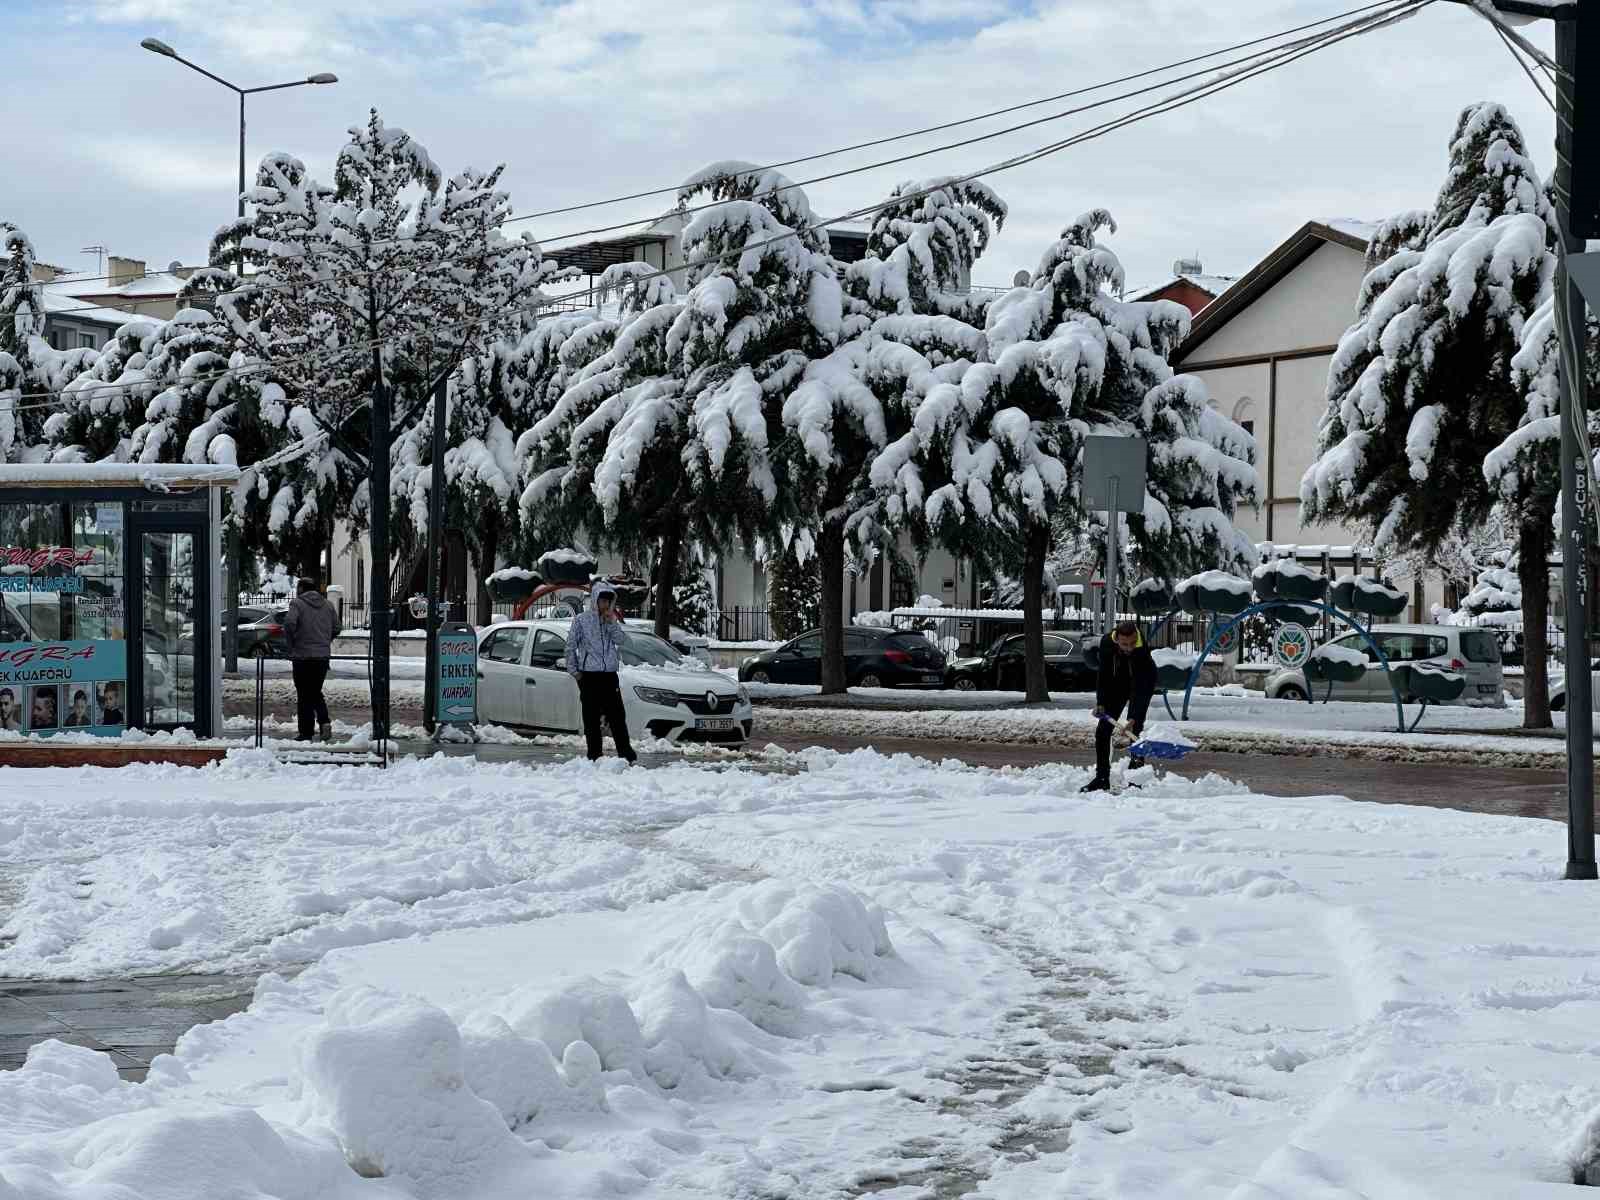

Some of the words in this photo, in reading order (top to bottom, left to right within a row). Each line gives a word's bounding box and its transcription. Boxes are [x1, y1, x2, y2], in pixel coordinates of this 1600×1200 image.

[15, 667, 72, 681] KUAFÖRÜ
[441, 663, 475, 678] ERKEK
[442, 683, 472, 699] KUAFÖRÜ
